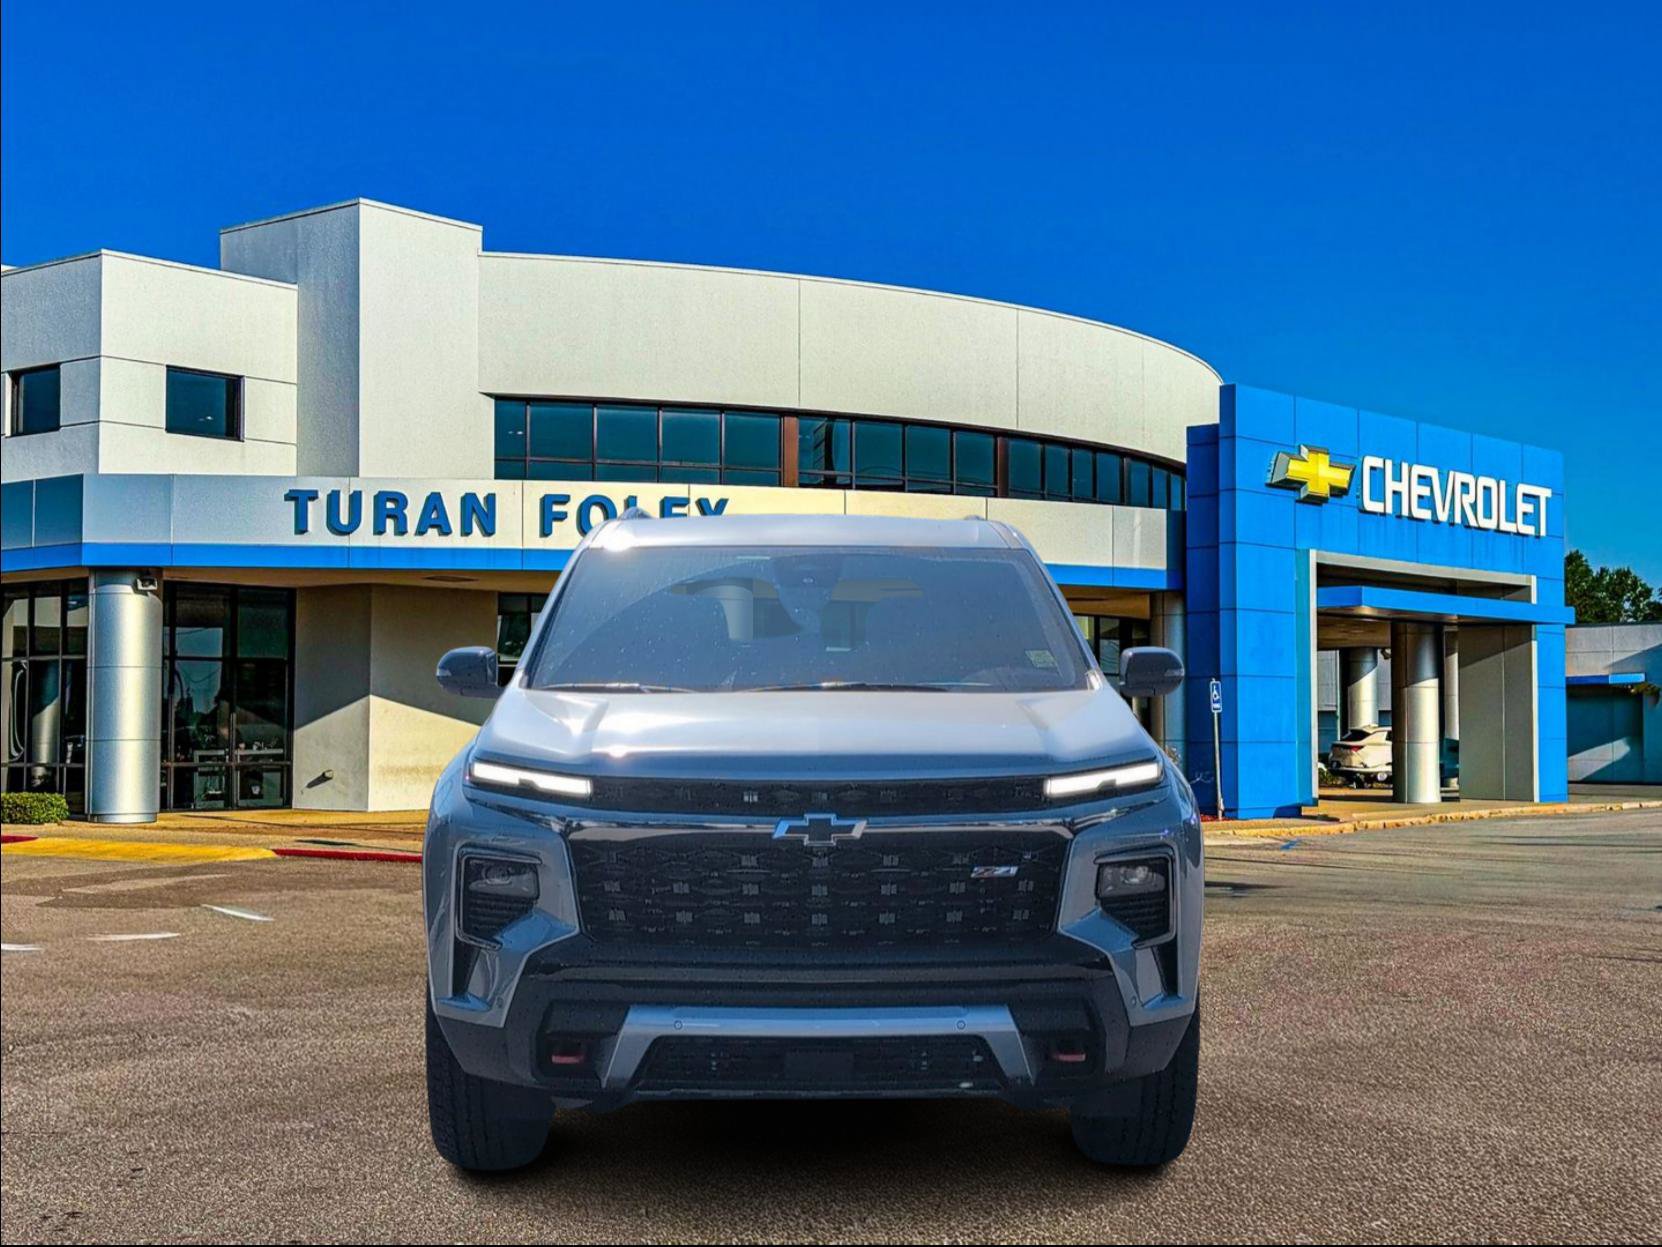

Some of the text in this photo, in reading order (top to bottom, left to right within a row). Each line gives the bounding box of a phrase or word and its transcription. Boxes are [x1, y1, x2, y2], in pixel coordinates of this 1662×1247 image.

[284, 489, 729, 538] TURAN FOEY
[1361, 455, 1551, 536] CHEVROLET
